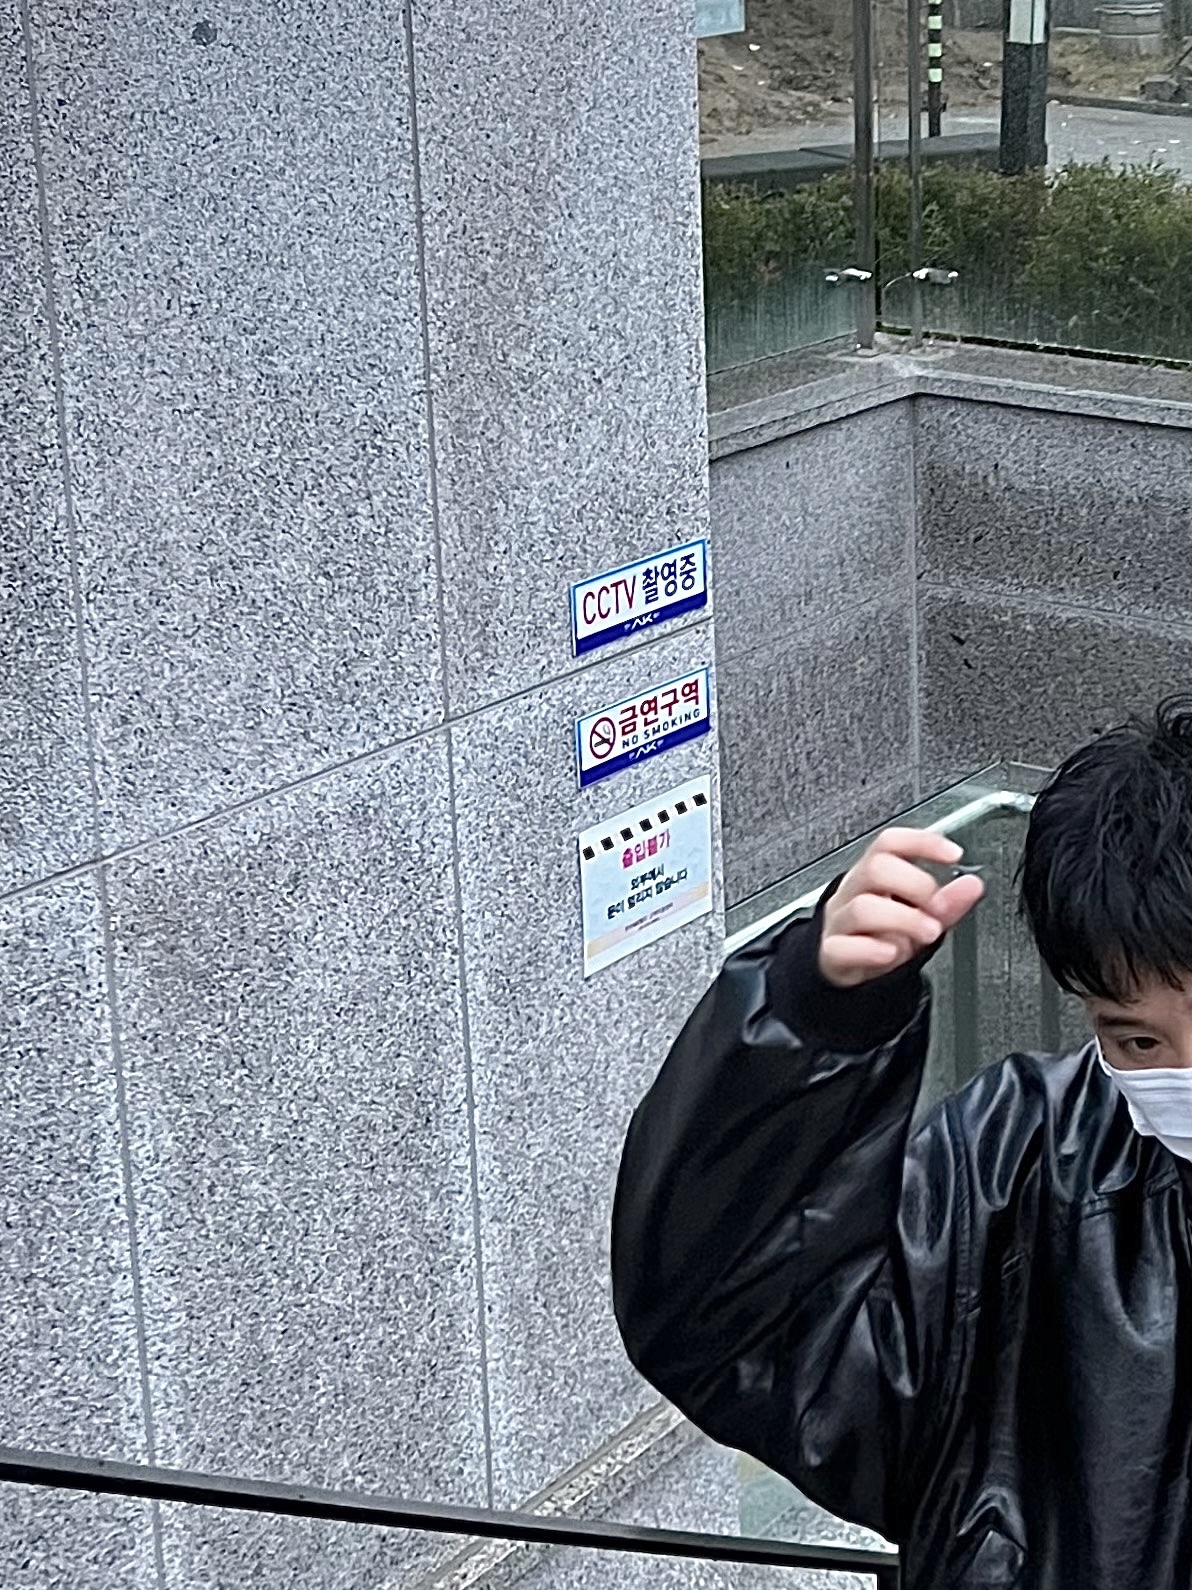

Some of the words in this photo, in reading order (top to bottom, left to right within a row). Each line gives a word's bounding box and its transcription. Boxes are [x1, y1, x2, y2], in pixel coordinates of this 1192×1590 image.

[583, 575, 636, 625] CCTV
[642, 552, 697, 605] 촬영중
[618, 678, 699, 737] 금연구역
[622, 735, 639, 750] NO
[643, 708, 701, 740] SMOKING
